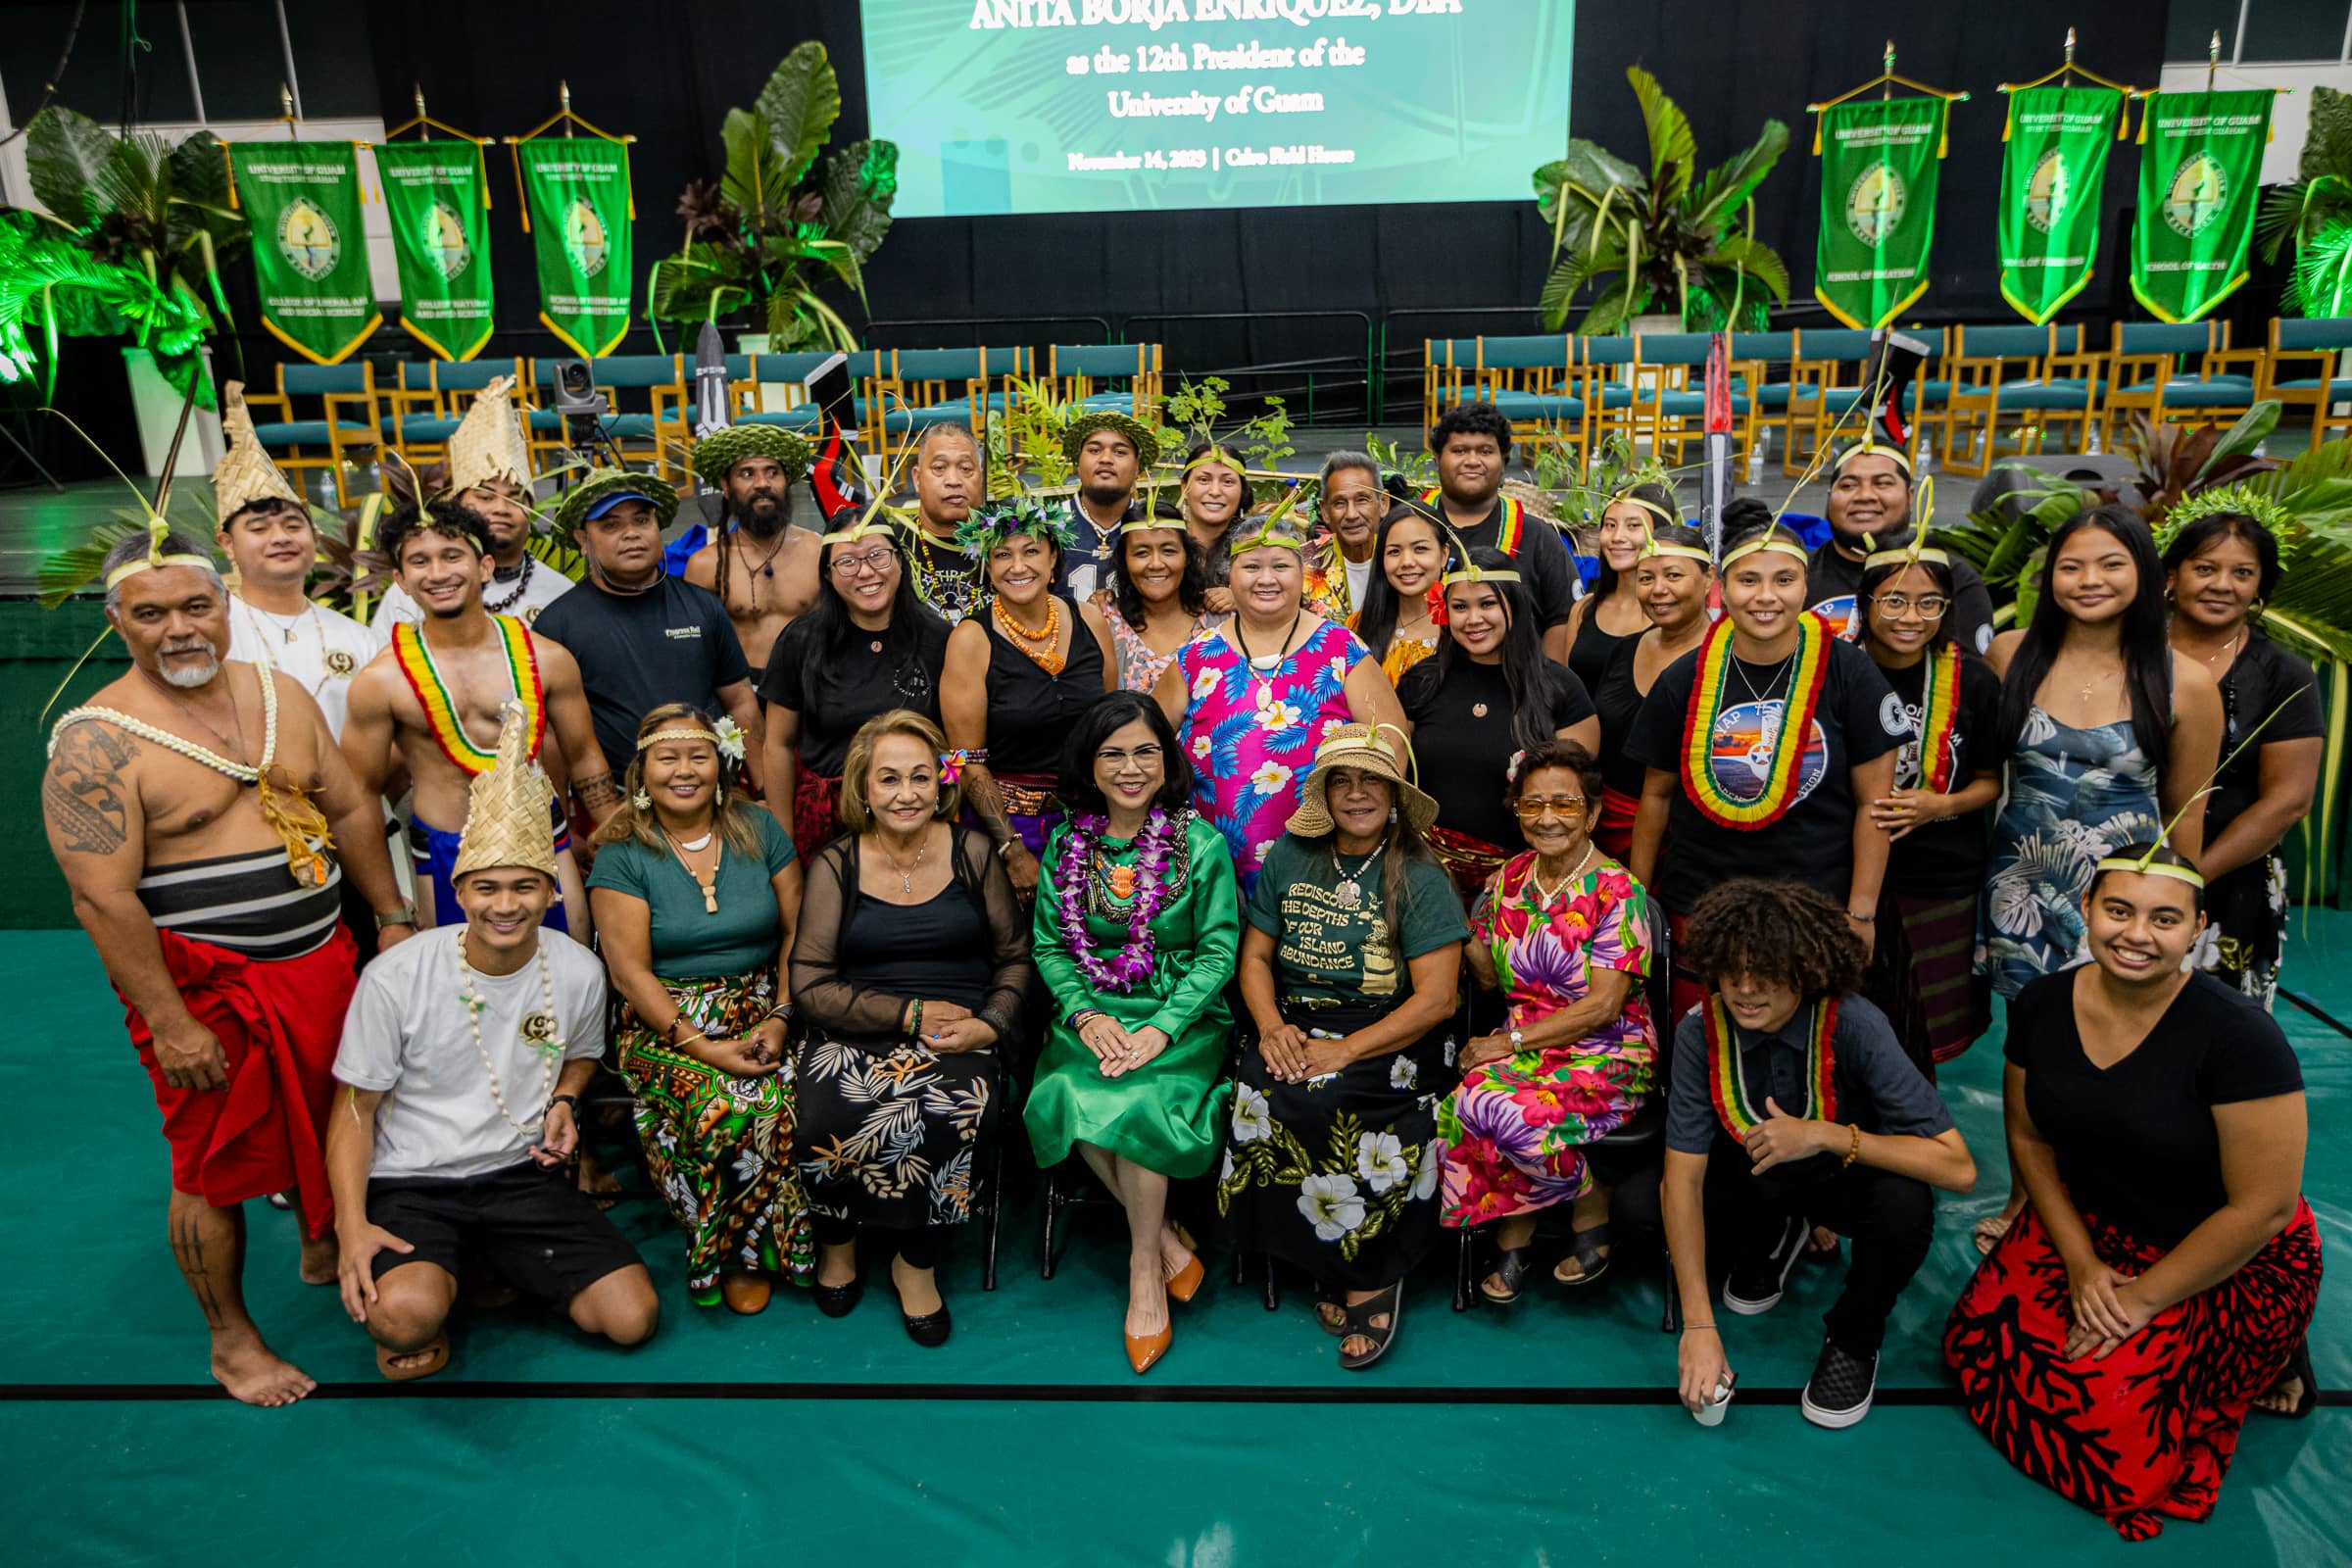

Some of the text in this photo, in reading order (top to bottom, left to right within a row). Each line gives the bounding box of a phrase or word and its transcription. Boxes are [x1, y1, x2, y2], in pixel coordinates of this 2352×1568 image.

[970, 0, 1076, 28] ANITA
[1081, 0, 1189, 30] BORJA
[1195, 0, 1381, 25] ENRIQUEZ,
[1066, 37, 1365, 74] as the 12th President of the
[1107, 85, 1324, 122] University of Guam
[1067, 151, 1142, 171] November
[1269, 145, 1306, 165] Field
[1307, 145, 1354, 165] House
[1281, 900, 1349, 927] THE DEPTHS
[1298, 920, 1323, 937] OUR
[1280, 945, 1355, 970] ABUNDANCE
[1299, 936, 1347, 955] ISLAND
